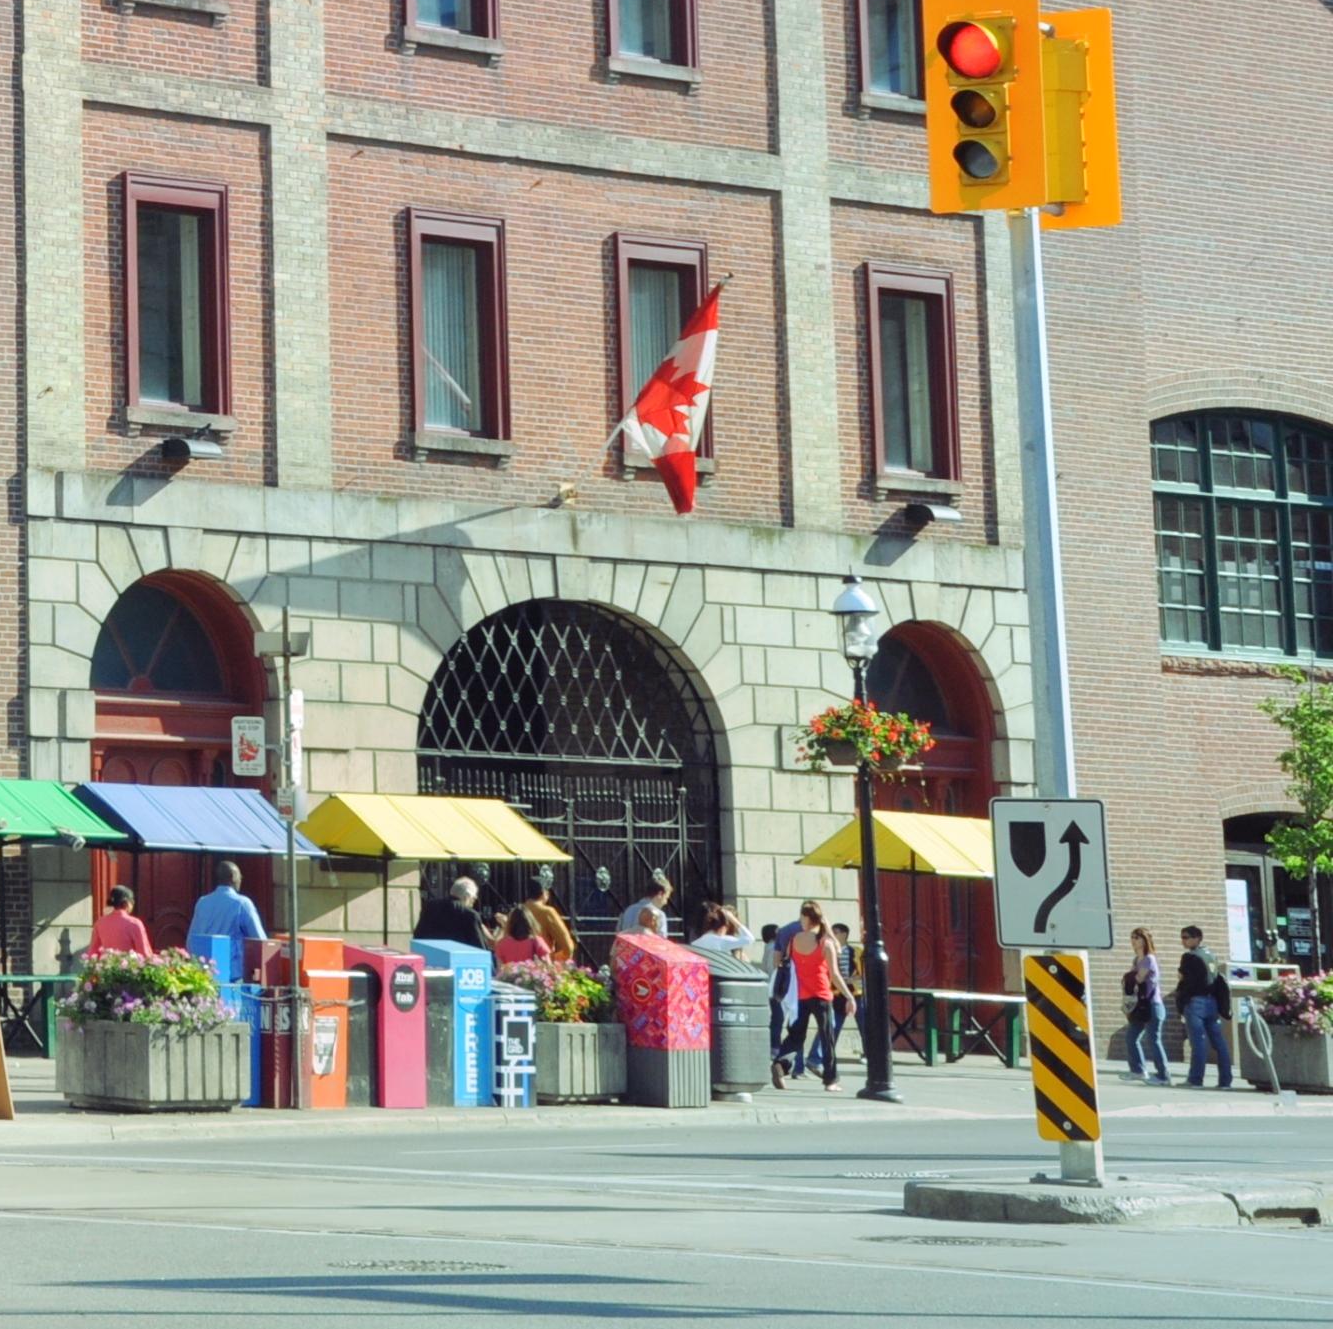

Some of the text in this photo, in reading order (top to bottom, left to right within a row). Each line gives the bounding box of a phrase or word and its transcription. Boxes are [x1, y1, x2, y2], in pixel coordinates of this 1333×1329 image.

[458, 968, 485, 984] JOB
[395, 991, 414, 1004] fab
[465, 1013, 478, 1094] FREE
